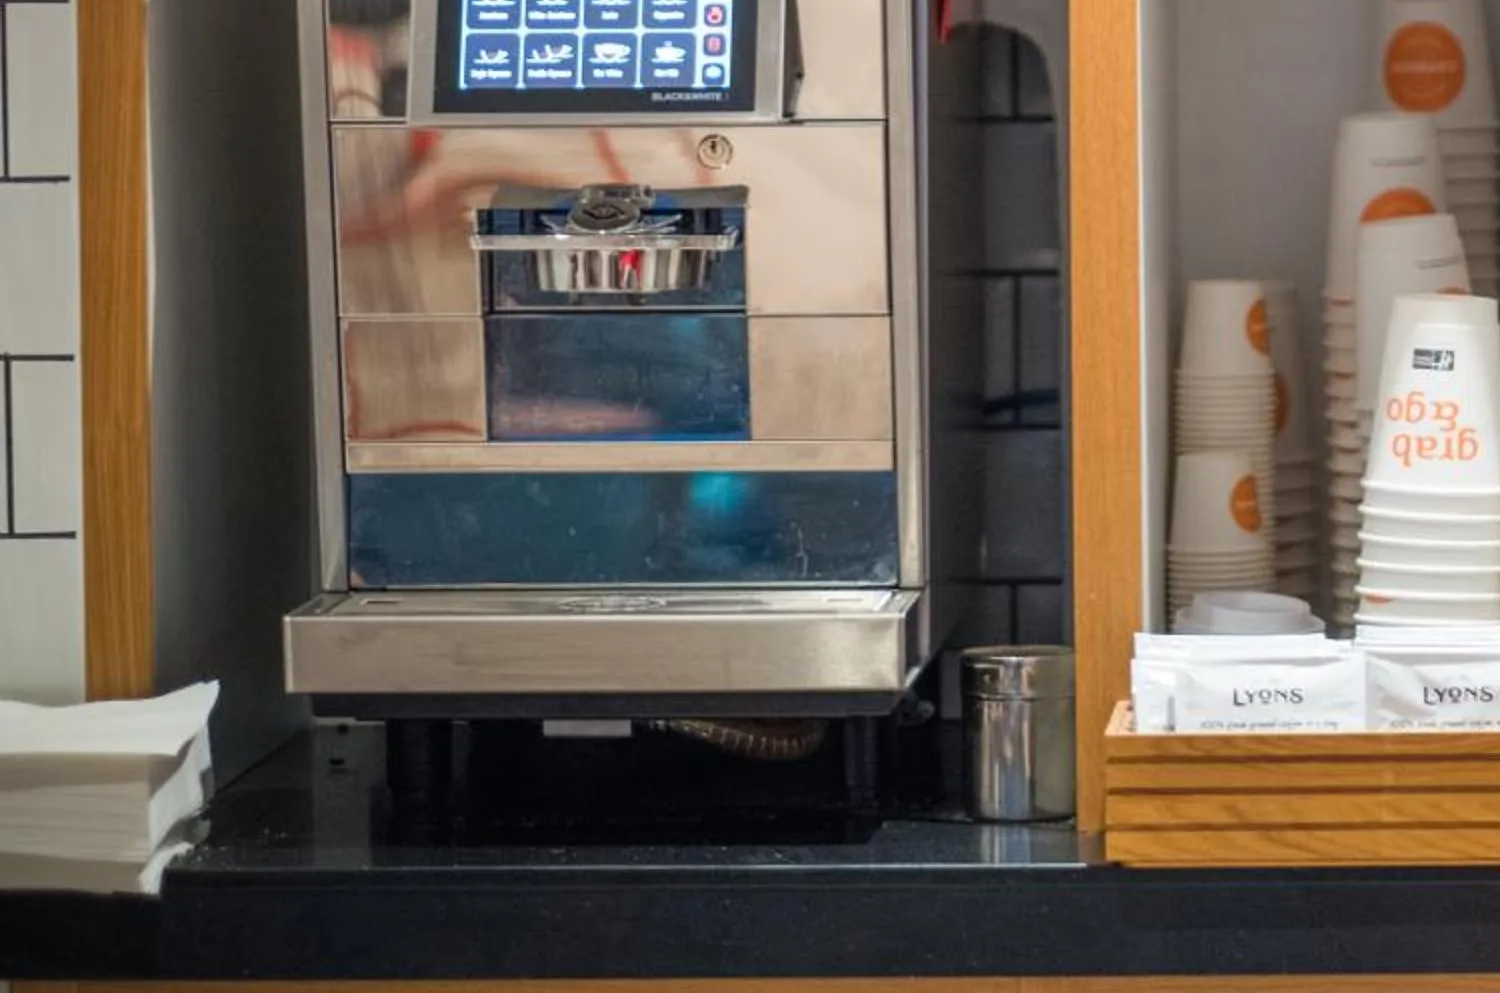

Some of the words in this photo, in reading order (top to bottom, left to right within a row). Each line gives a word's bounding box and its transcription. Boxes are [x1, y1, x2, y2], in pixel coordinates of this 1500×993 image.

[1386, 391, 1426, 423] go
[1392, 427, 1478, 468] grab
[1232, 687, 1304, 707] LYONS
[1423, 685, 1495, 705] LYONS
